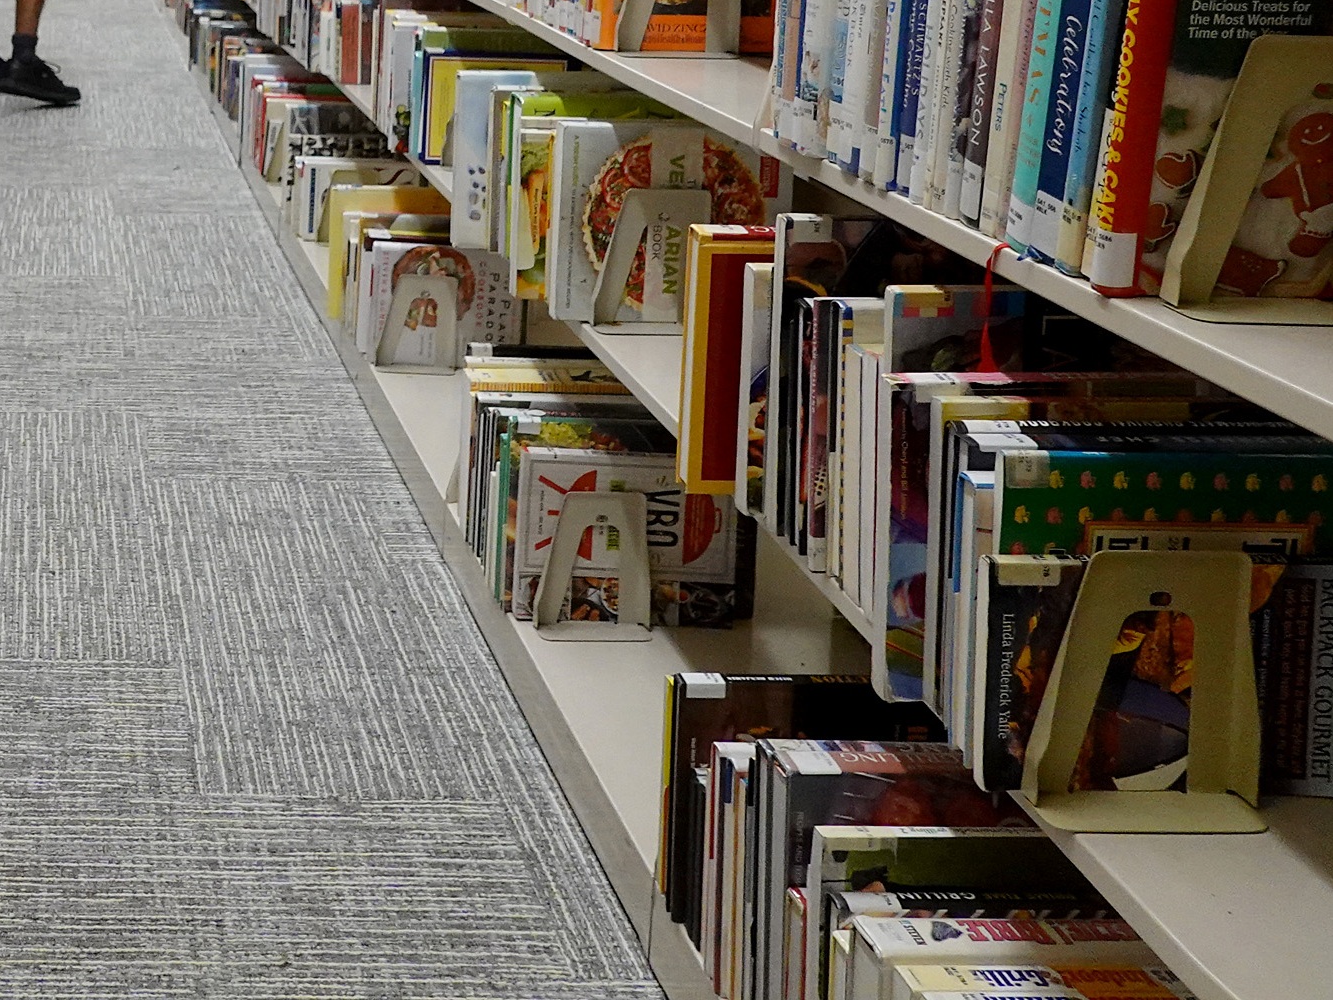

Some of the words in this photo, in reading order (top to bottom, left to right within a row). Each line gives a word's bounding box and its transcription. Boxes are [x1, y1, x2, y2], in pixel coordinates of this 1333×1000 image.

[945, 3, 959, 53] Cooking
[1189, 13, 1210, 26] the
[1212, 13, 1245, 26] Most
[1247, 13, 1312, 27] Wonderful
[1190, 0, 1249, 13] Delicious
[1251, 0, 1290, 13] Treats
[1292, 0, 1312, 13] for
[910, 2, 928, 97] SCHWARTZ'S
[1187, 27, 1218, 40] Time
[1220, 27, 1236, 40] of
[1237, 27, 1258, 40] the
[969, 45, 992, 147] LAWSON
[994, 81, 1008, 132] PETERS
[1046, 14, 1083, 156] Celebrations
[1111, 29, 1138, 148] COOKIES
[484, 272, 499, 342] PARADO
[497, 299, 511, 344] PLAN
[1001, 612, 1015, 647] Linda
[998, 650, 1015, 707] Frederick
[996, 709, 1012, 740] Yaffe
[1310, 684, 1332, 783] GOURMET
[896, 889, 976, 901] GRILLIN
[955, 920, 1039, 943] BIBLE
